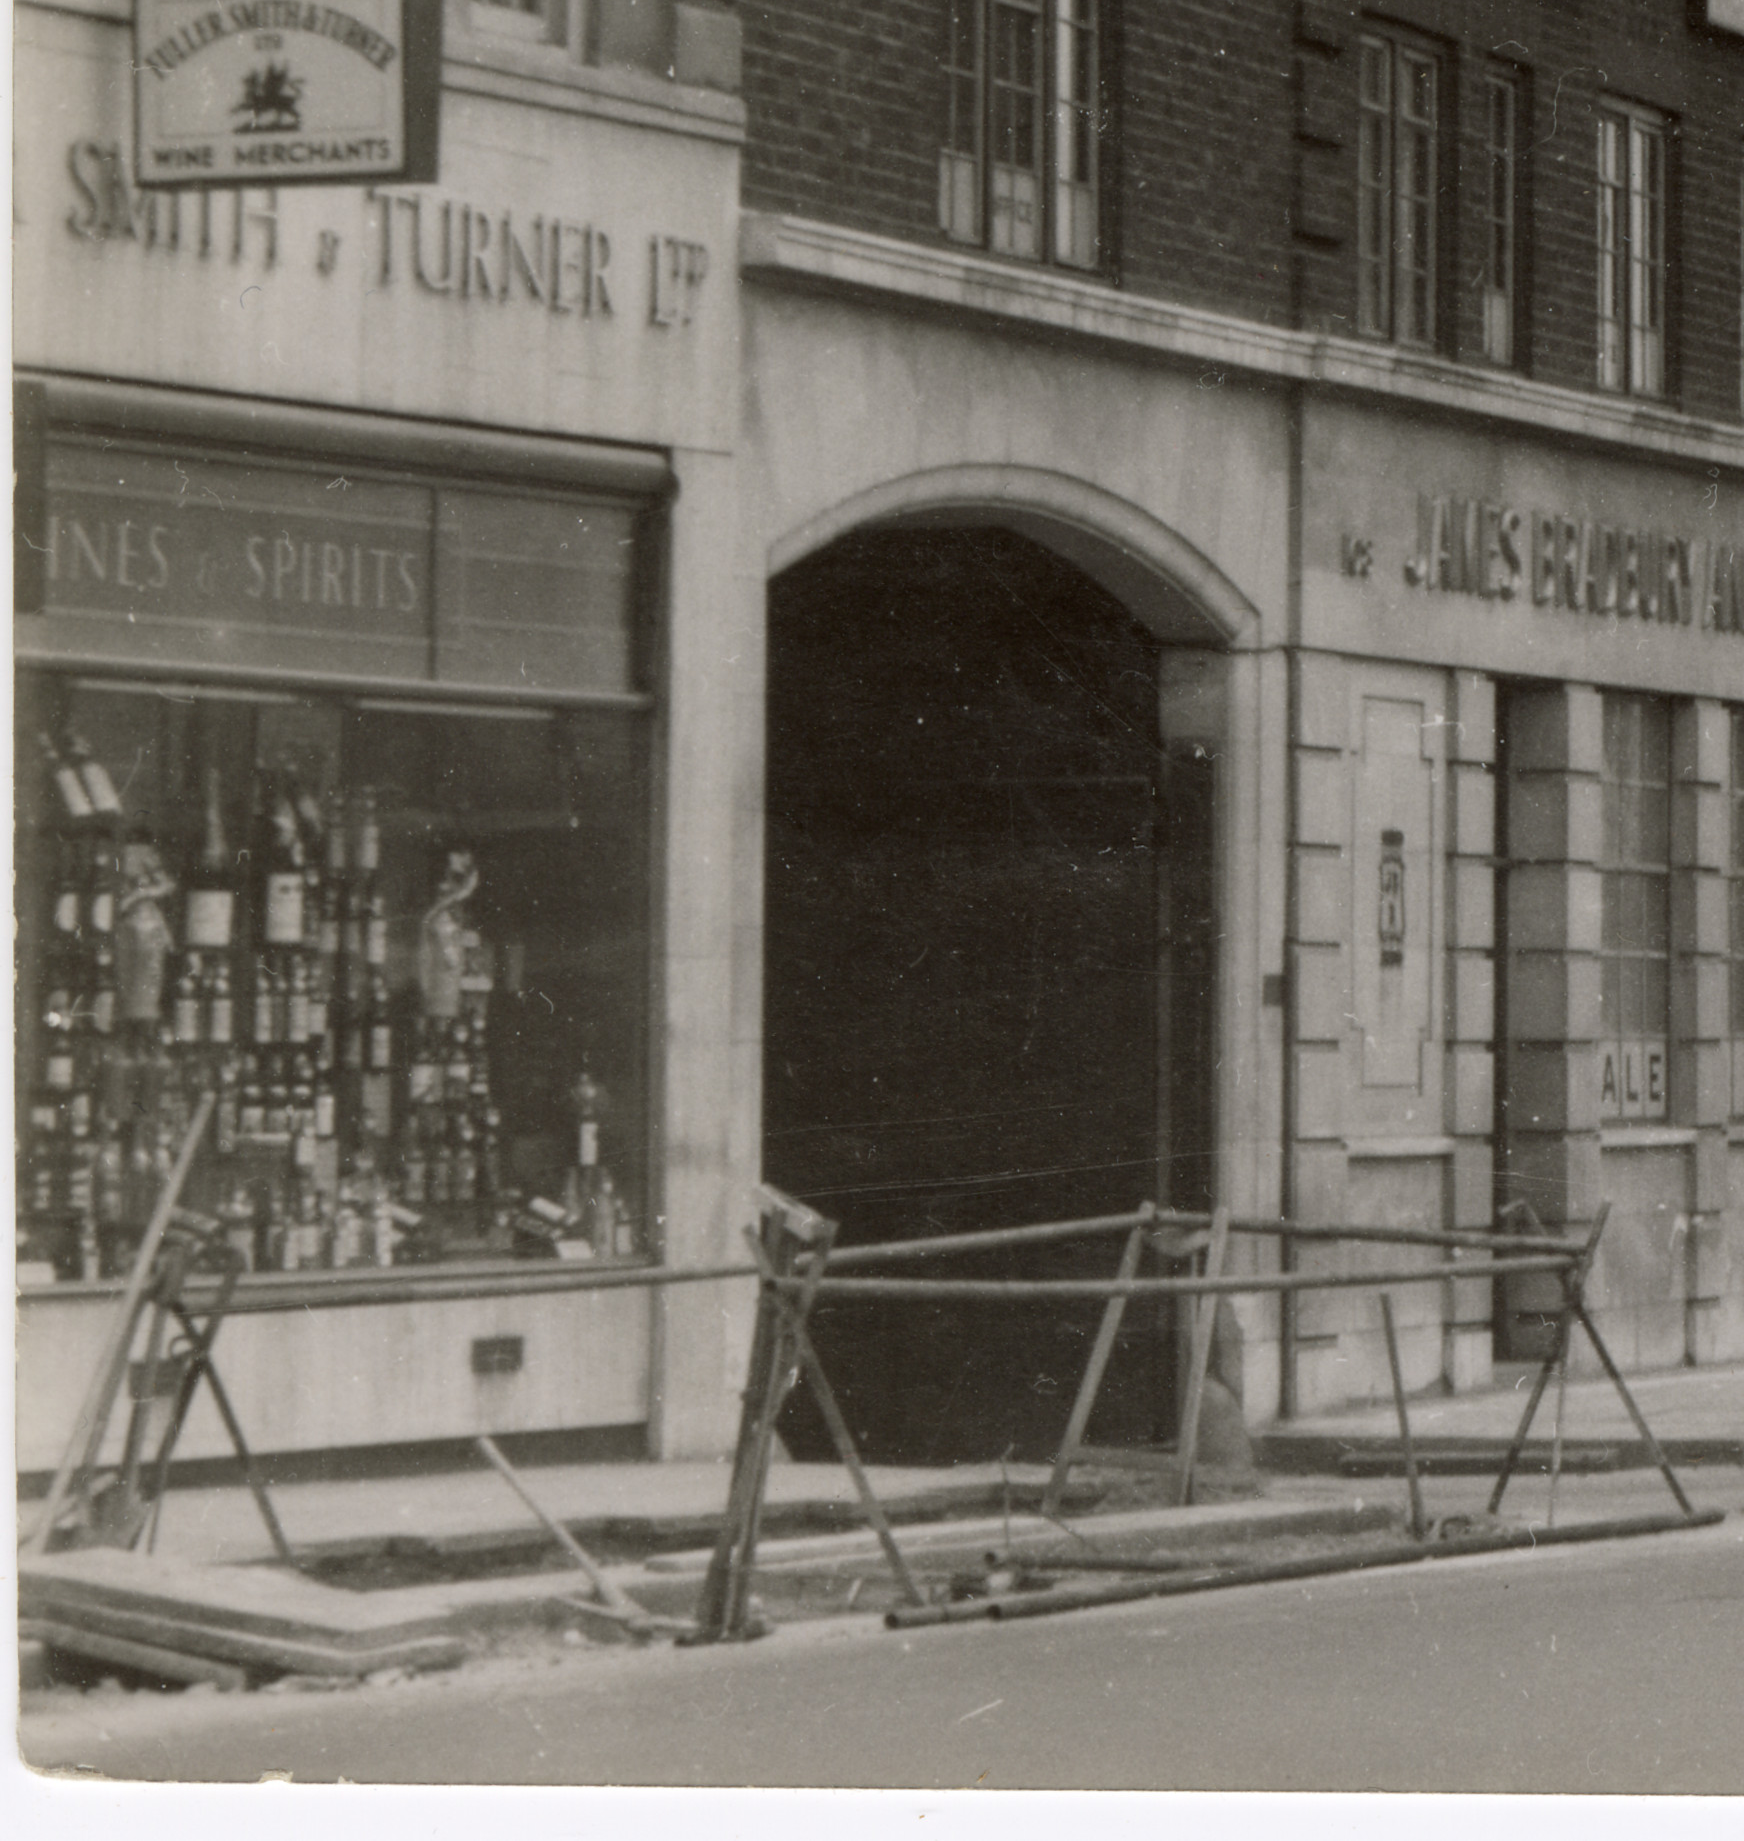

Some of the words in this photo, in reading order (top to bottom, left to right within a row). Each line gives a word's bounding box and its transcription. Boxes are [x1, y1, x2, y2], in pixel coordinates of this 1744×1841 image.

[152, 144, 213, 168] WINE
[234, 137, 391, 165] MERCHANTS
[365, 190, 612, 320] TURNER
[245, 535, 419, 612] SPIRITS
